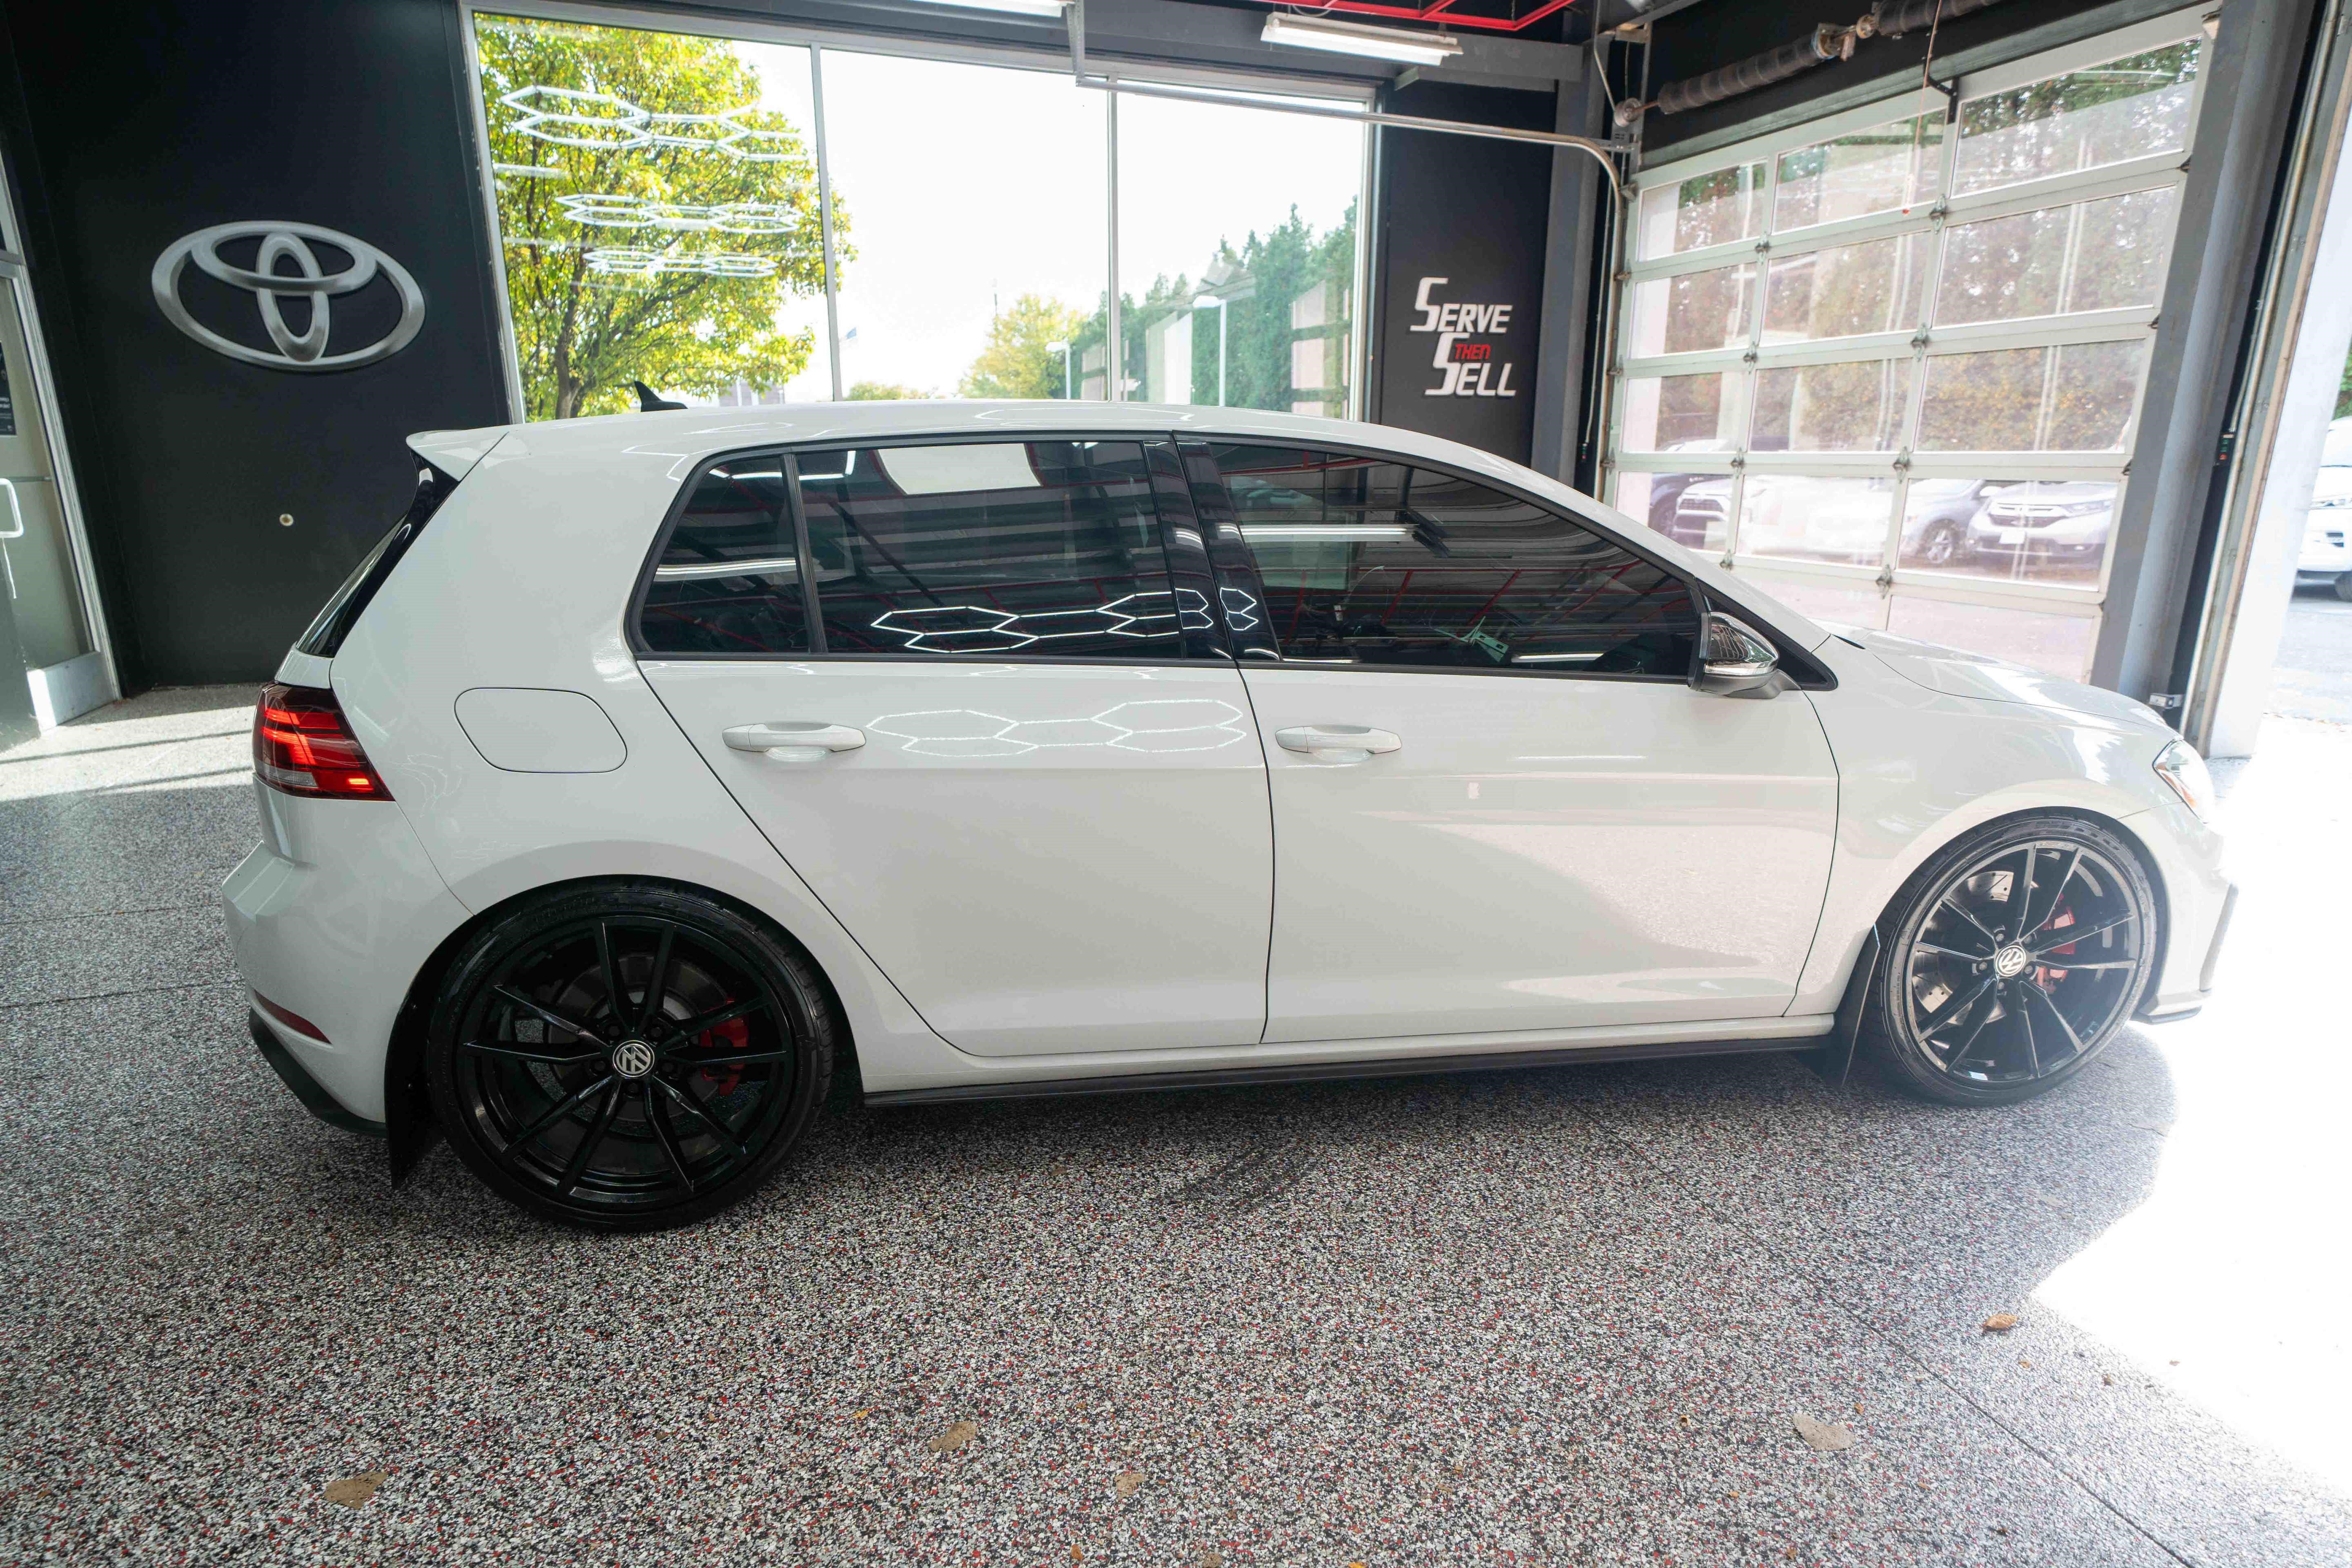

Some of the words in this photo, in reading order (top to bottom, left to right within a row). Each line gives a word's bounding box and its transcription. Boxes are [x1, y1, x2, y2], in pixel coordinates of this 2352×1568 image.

[1410, 277, 1512, 333] SERVE
[1425, 332, 1516, 396] SELL
[1455, 344, 1491, 360] THEN
